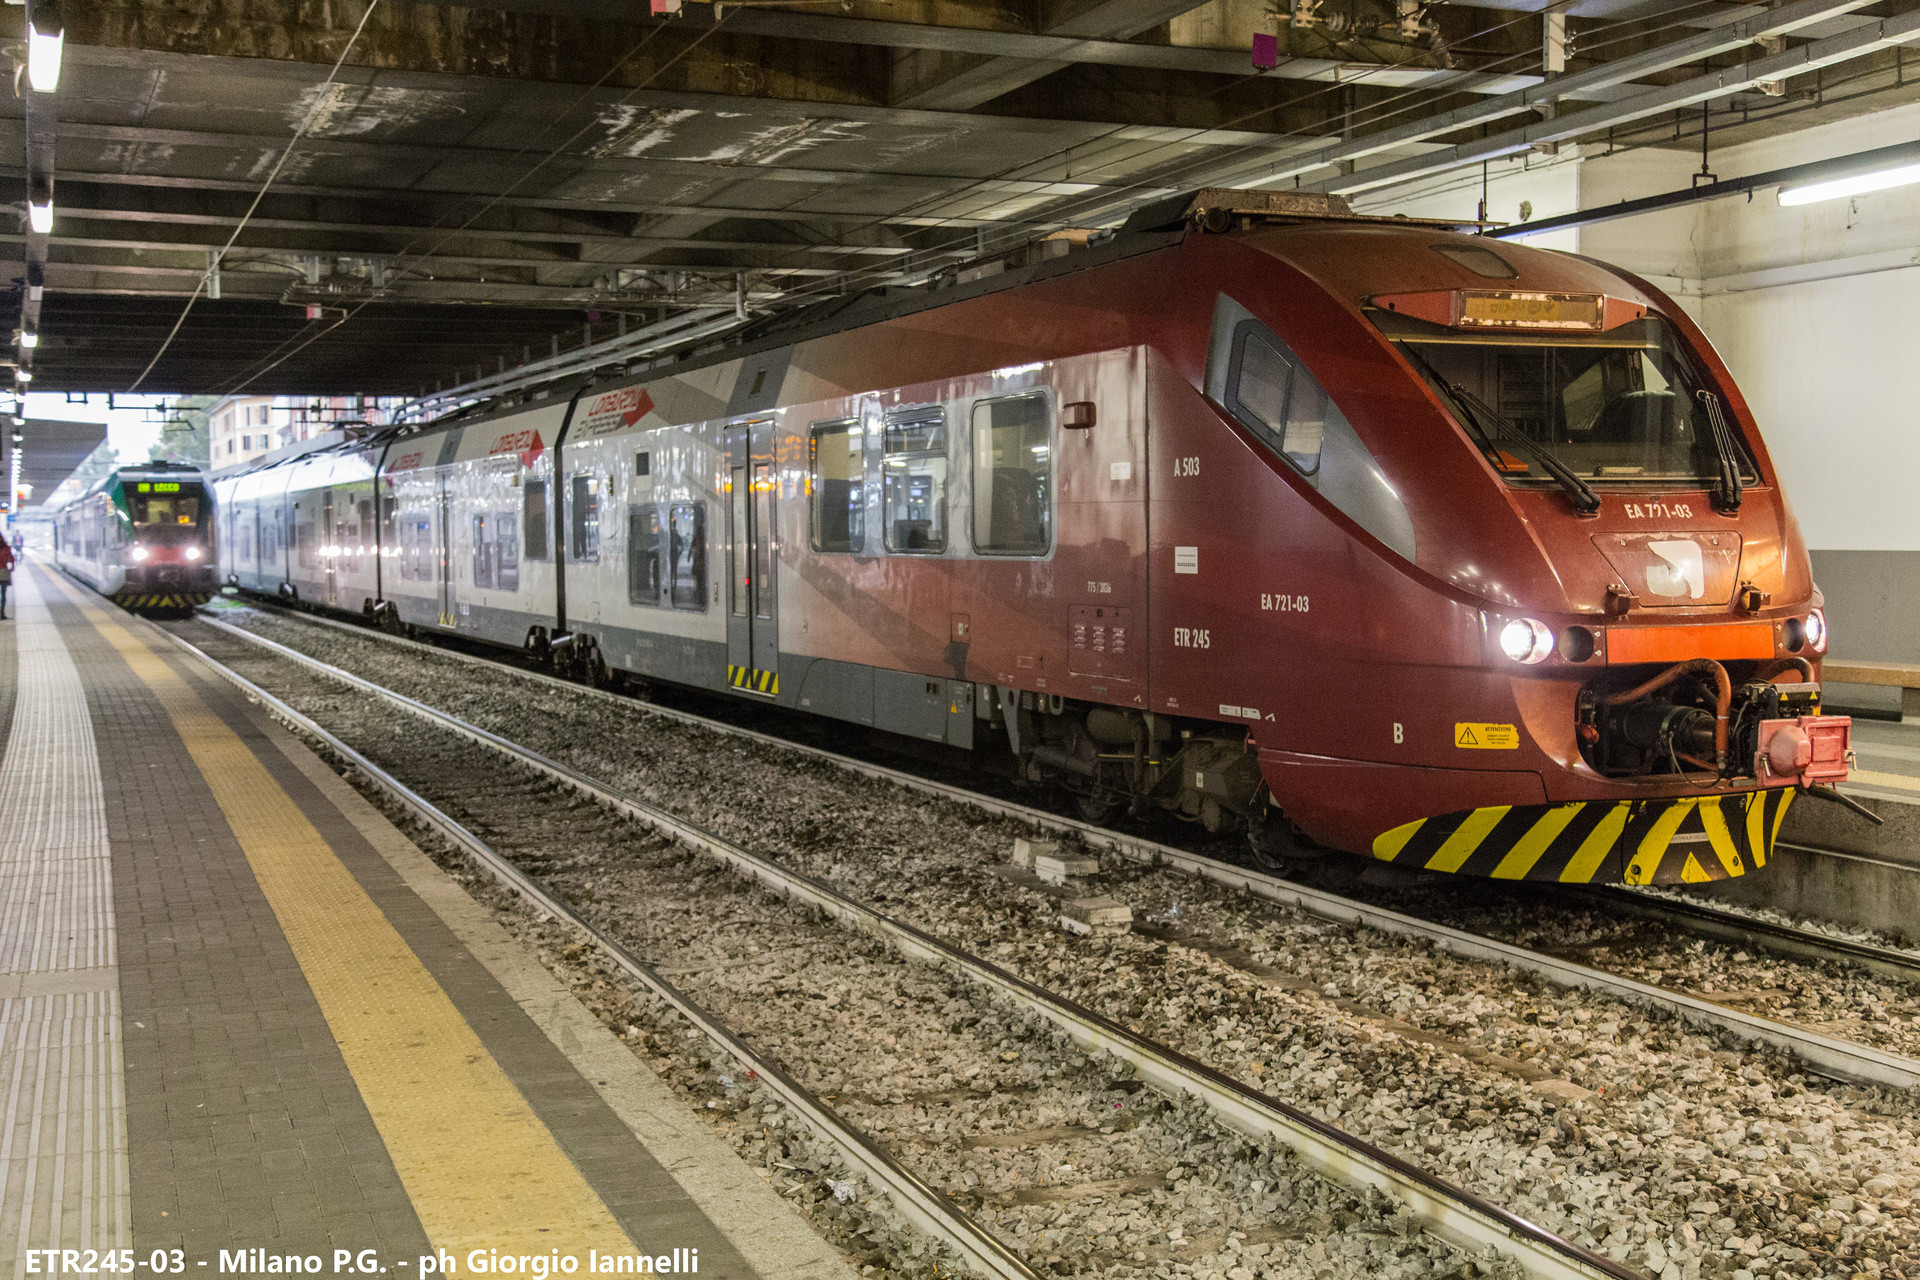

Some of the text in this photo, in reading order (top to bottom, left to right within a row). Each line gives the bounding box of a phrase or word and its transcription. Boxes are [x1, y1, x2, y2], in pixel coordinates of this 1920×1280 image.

[1174, 456, 1200, 477] A 503
[1624, 503, 1645, 519] EA
[1261, 593, 1310, 613] EA 721-03
[1174, 627, 1210, 649] ETR 245
[1393, 722, 1404, 744] B
